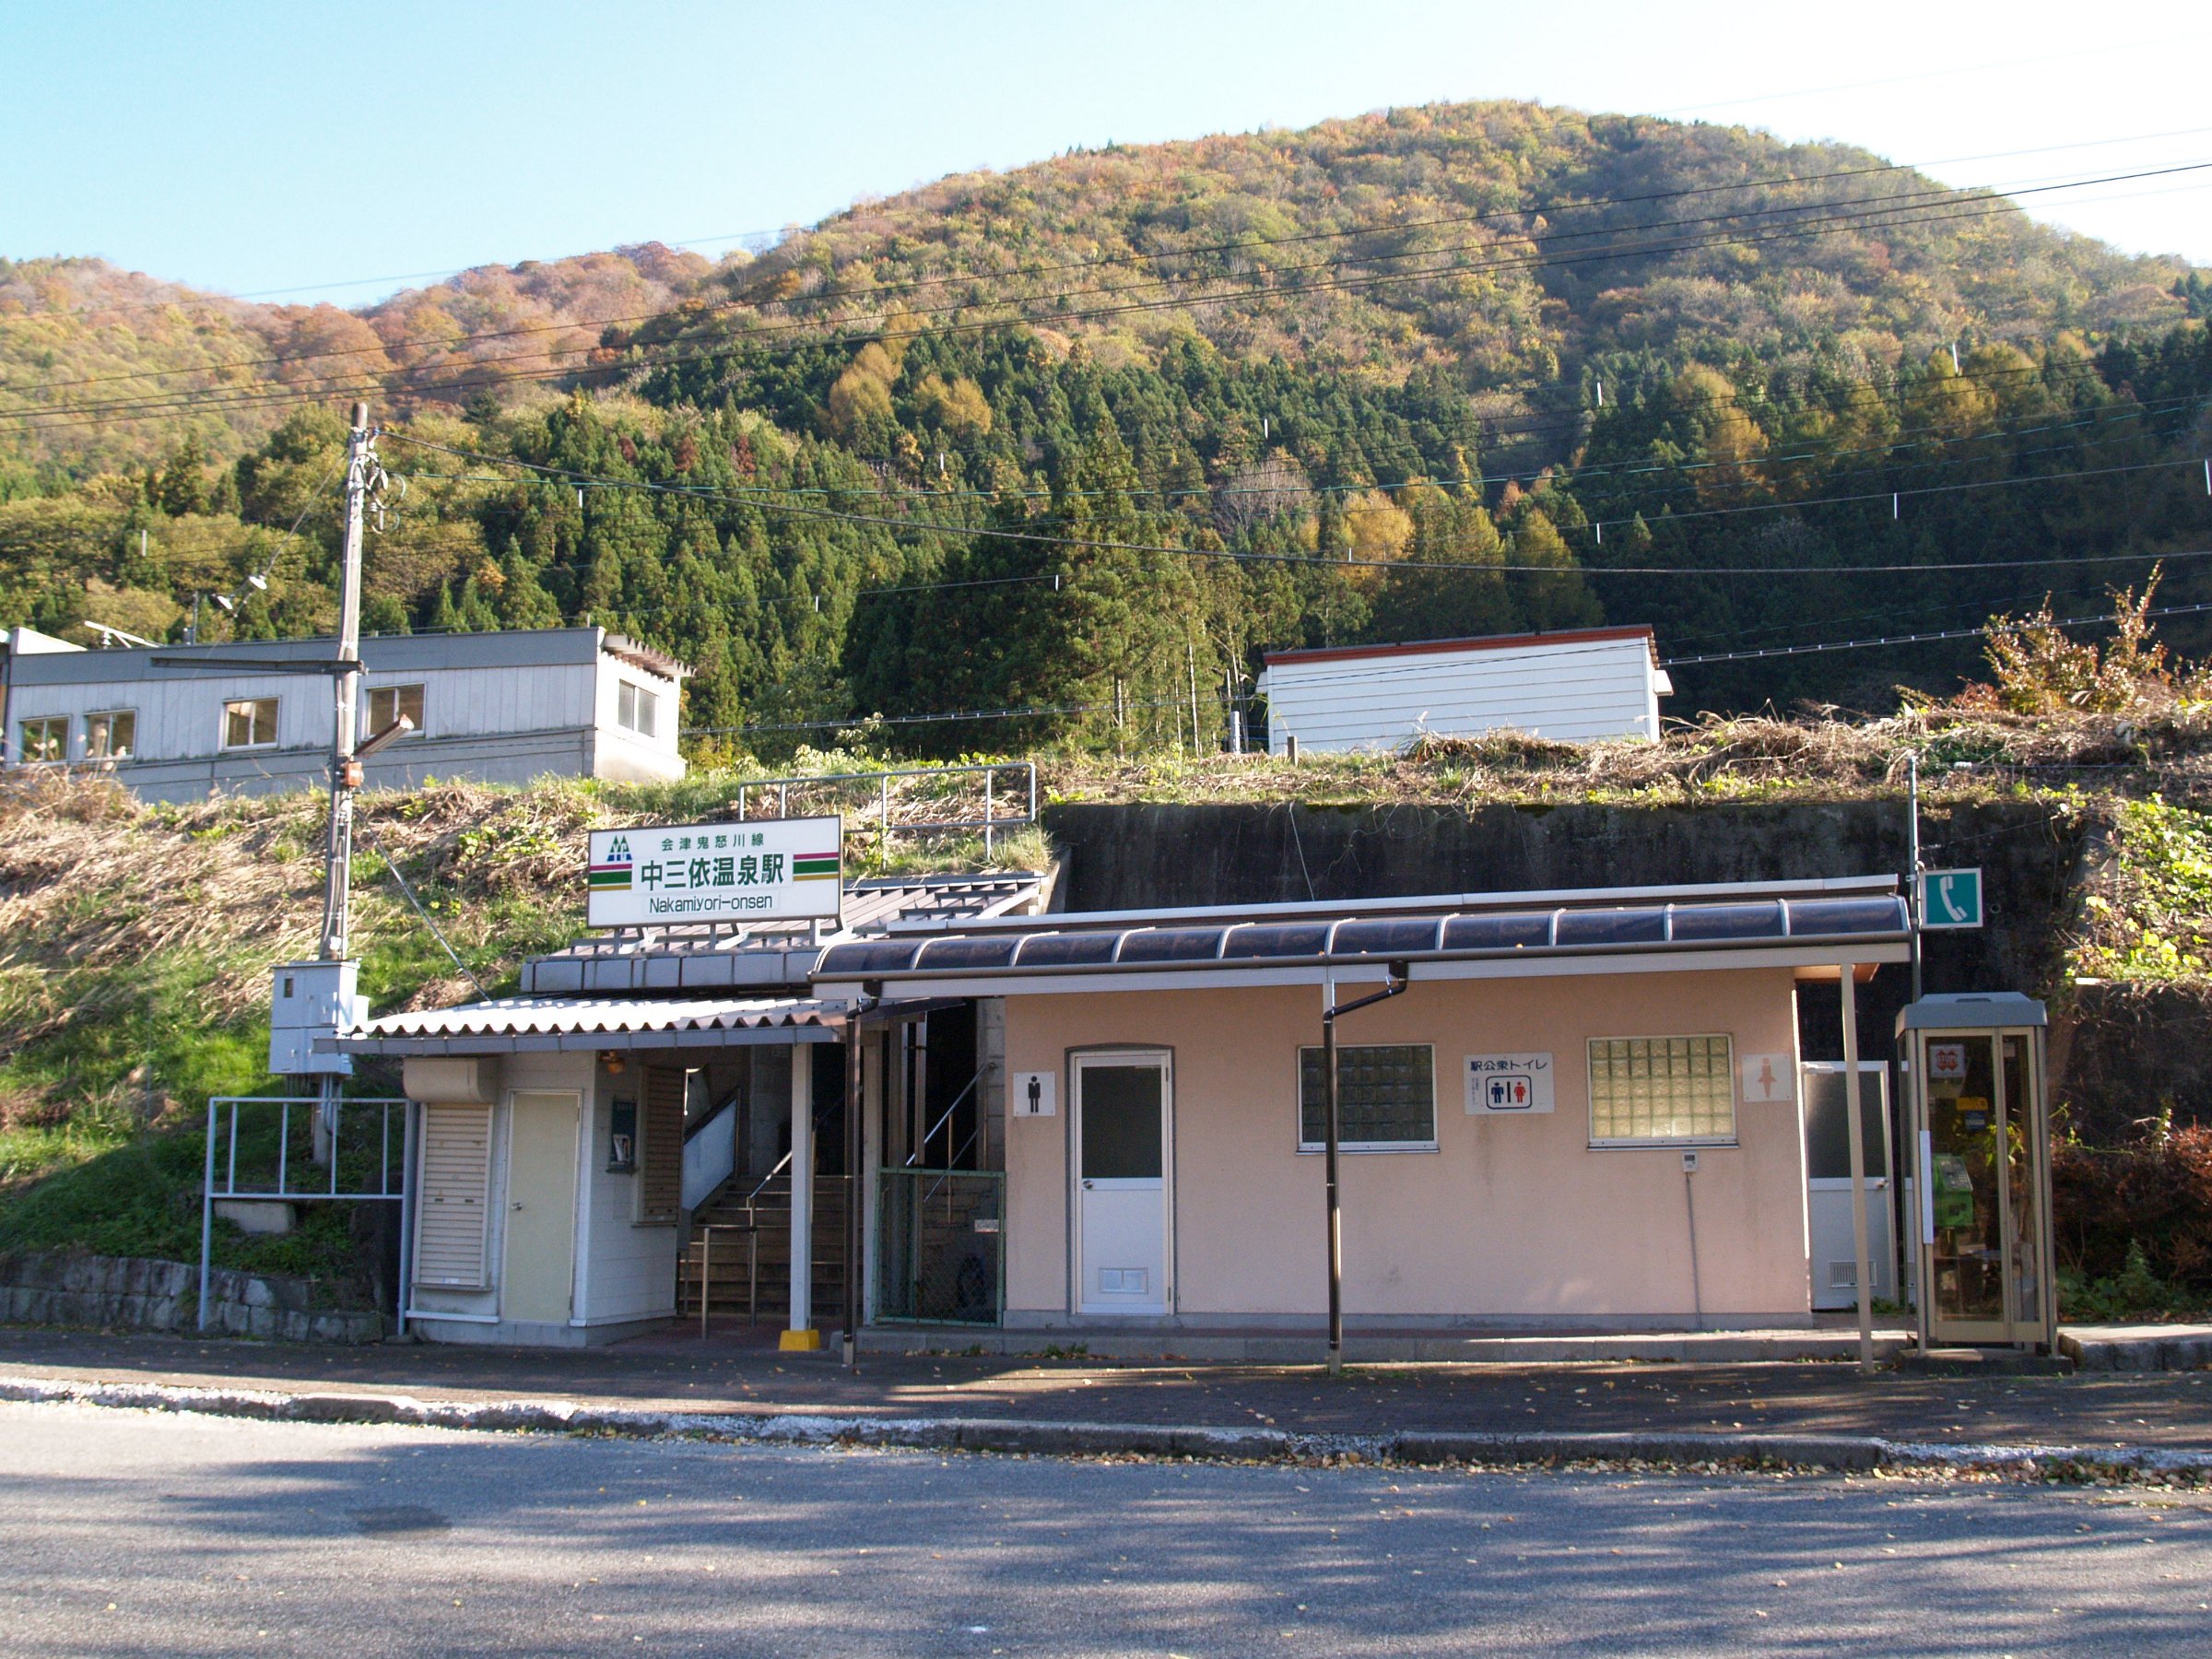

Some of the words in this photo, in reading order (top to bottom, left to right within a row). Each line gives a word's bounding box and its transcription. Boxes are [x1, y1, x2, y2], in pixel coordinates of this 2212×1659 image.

[661, 833, 764, 852] 会津鬼怒川線
[641, 853, 783, 891] 中三依温泉駅
[649, 895, 772, 913] Nakamiyori-onsen
[1470, 1059, 1547, 1072] 駅公衆トイレ
